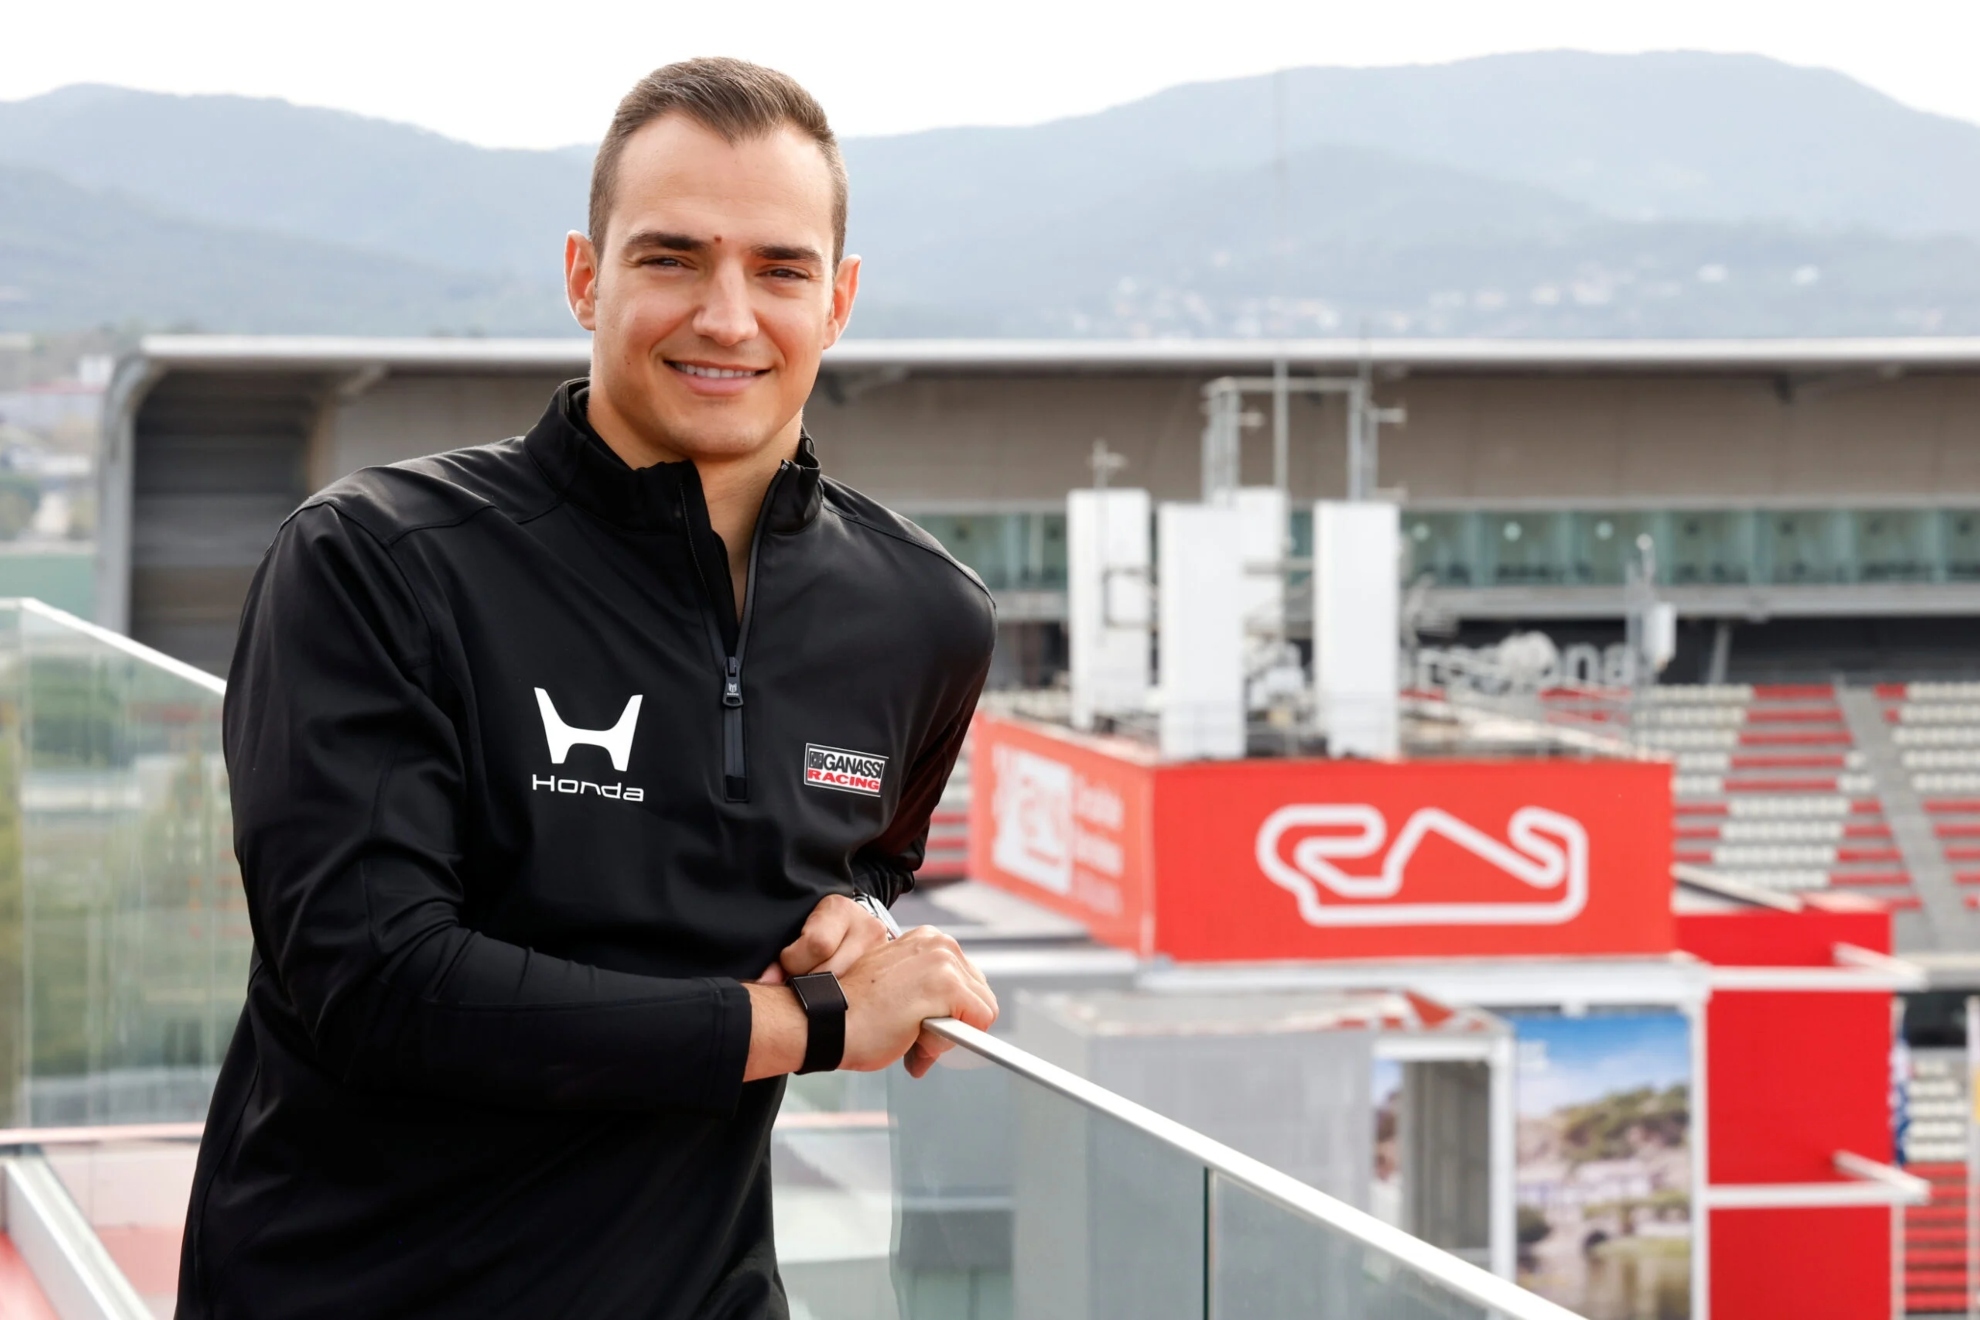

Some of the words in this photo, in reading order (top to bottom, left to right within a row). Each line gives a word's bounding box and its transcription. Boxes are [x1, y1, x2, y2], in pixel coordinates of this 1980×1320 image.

[807, 768, 880, 791] RACING
[824, 753, 884, 780] GANASSI
[532, 774, 645, 802] Honda
